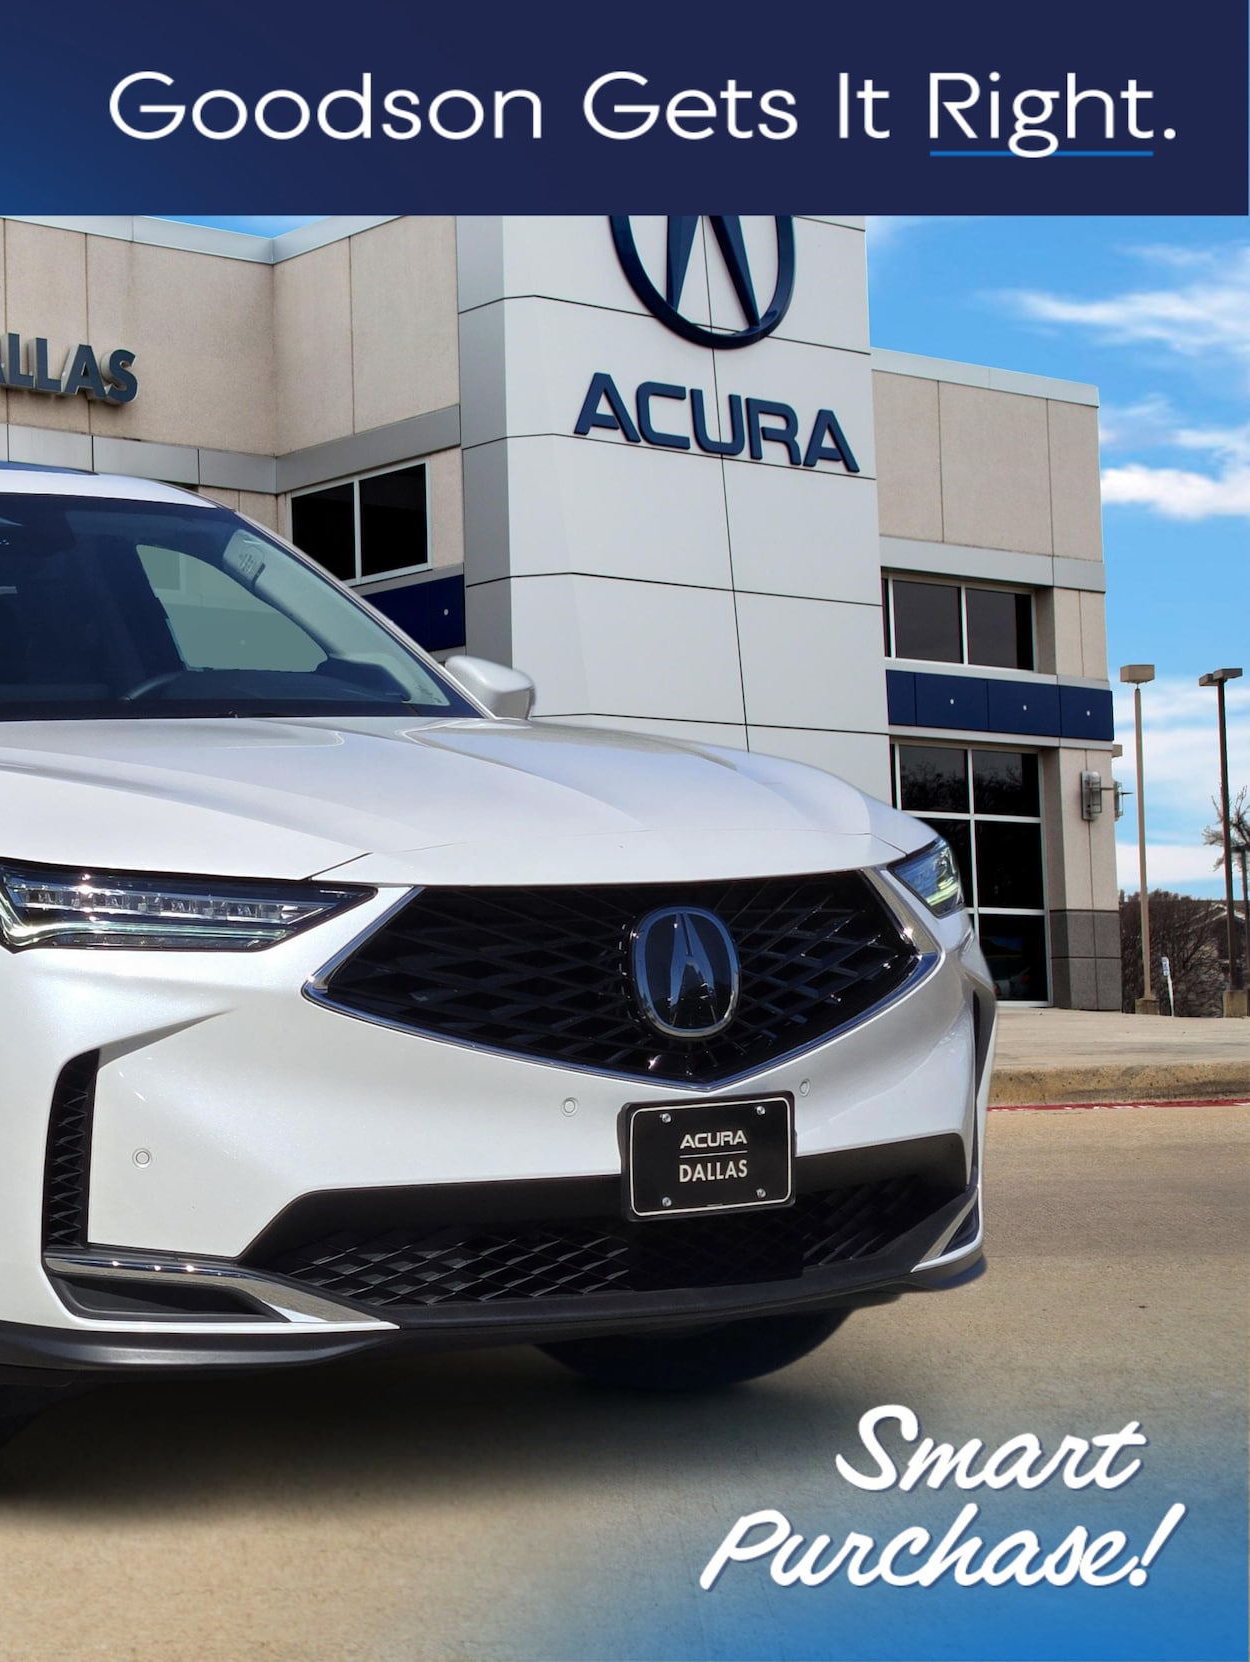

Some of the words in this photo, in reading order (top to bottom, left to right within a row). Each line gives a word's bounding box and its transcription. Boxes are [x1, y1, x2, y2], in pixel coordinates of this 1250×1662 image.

[574, 372, 860, 474] ACURA
[679, 1130, 748, 1149] ACURA
[679, 1159, 748, 1183] DALLAS
